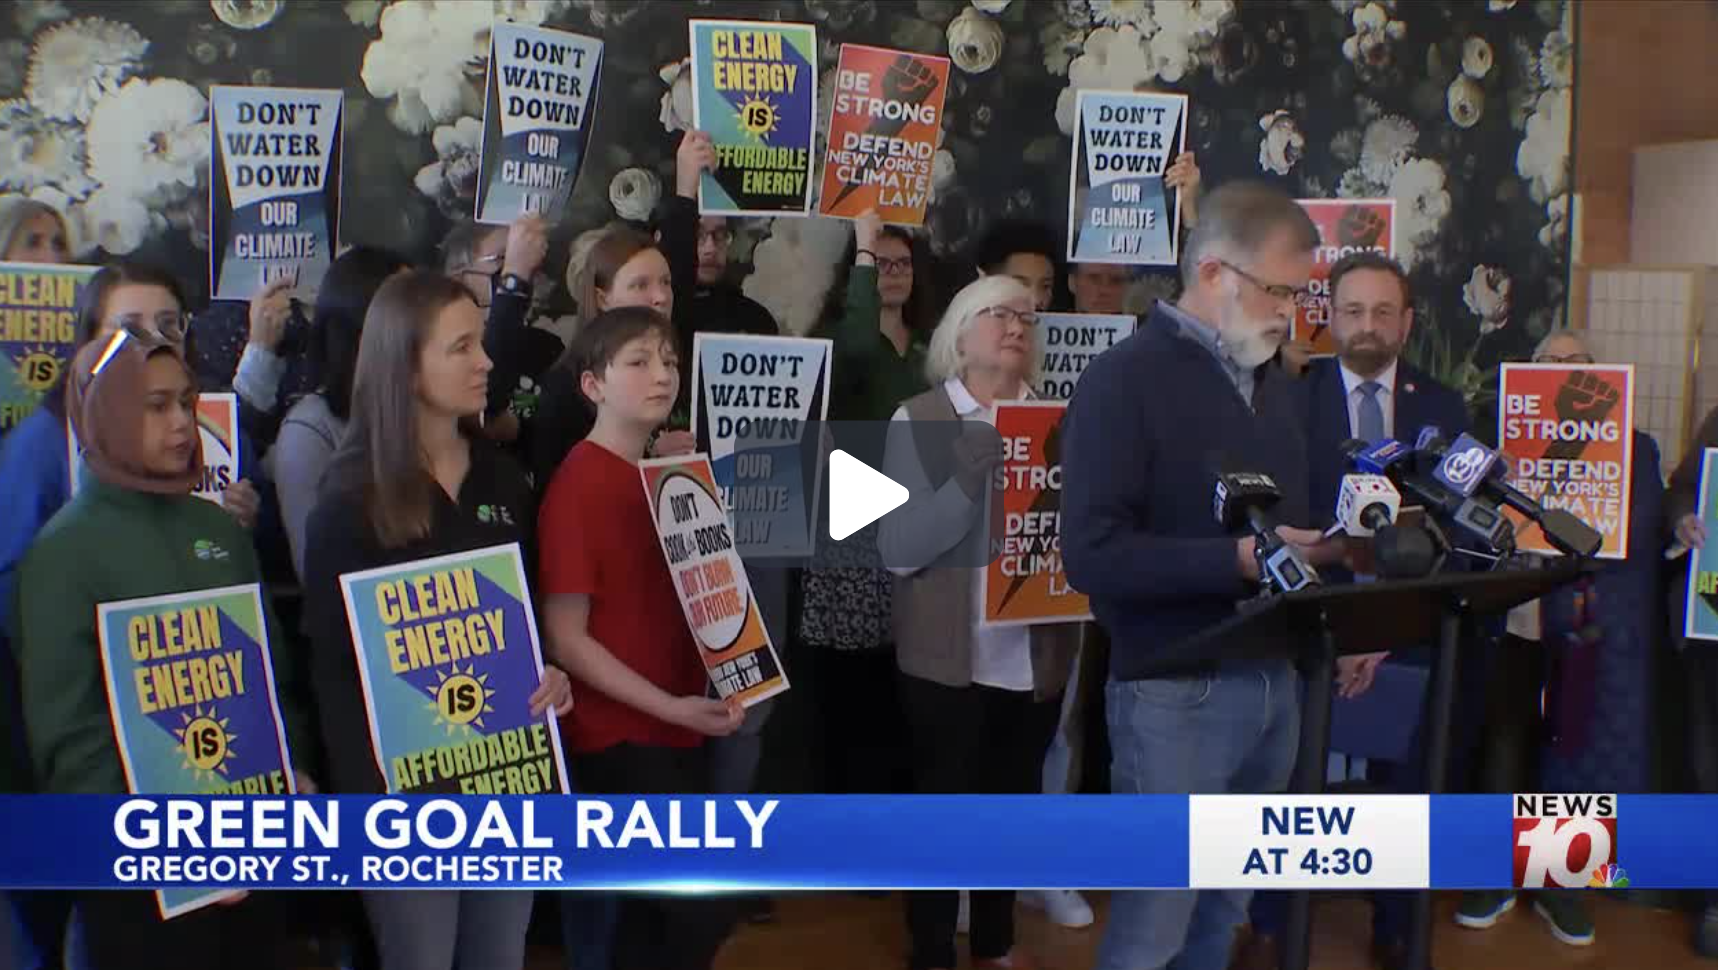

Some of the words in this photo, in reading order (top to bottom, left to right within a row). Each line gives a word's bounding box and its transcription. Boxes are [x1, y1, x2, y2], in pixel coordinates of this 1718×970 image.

[514, 37, 586, 68] DON'T
[713, 30, 782, 59] CLEAN
[502, 65, 582, 98] WATER
[714, 62, 797, 93] ENERGY
[839, 69, 872, 92] BE
[237, 102, 321, 126] DON'T
[507, 96, 580, 127] DOWN
[748, 108, 767, 127] IS
[836, 95, 936, 125] STRONG
[1099, 105, 1166, 125] DON'T
[227, 133, 321, 157] WATER
[528, 132, 560, 159] OUR
[843, 132, 932, 158] DEFEND
[1090, 130, 1163, 149] WATER
[715, 144, 806, 170] FFORDABLE
[828, 150, 868, 166] NEW
[873, 153, 929, 173] YORK'S
[1095, 153, 1162, 174] DOWN
[235, 164, 321, 188] DOWN
[742, 170, 805, 195] ENERGY
[836, 166, 927, 191] CLIMATE
[878, 189, 925, 208] LAW
[1112, 183, 1141, 203] OUR
[260, 202, 299, 227] OUR
[1091, 207, 1157, 230] CLIMATE
[234, 233, 316, 259] CLIMATE
[1108, 233, 1143, 255] LAW
[0, 309, 77, 343] NERG
[1046, 326, 1117, 346] DON'T
[28, 360, 53, 382] IS
[720, 352, 804, 378] DON'T
[711, 384, 801, 409] WATER
[1044, 380, 1075, 399] DO
[1506, 394, 1541, 415] BE
[716, 416, 800, 441] DOWN
[1506, 418, 1619, 442] STRONG
[736, 453, 773, 480] OUR
[993, 465, 1063, 491] STRO
[1519, 458, 1621, 481] DEFEND
[1552, 480, 1619, 496] YORK'S
[1542, 496, 1618, 516] IMATE
[1006, 512, 1061, 536] DEF
[694, 523, 732, 556] BOOKS
[375, 568, 480, 626] CLEAN
[128, 606, 222, 661] CLEAN
[384, 610, 507, 674] ENERGY
[134, 650, 245, 714] ENERGY
[447, 685, 475, 714] IS
[193, 727, 219, 759] IS
[392, 724, 550, 790] AFFORDABLE
